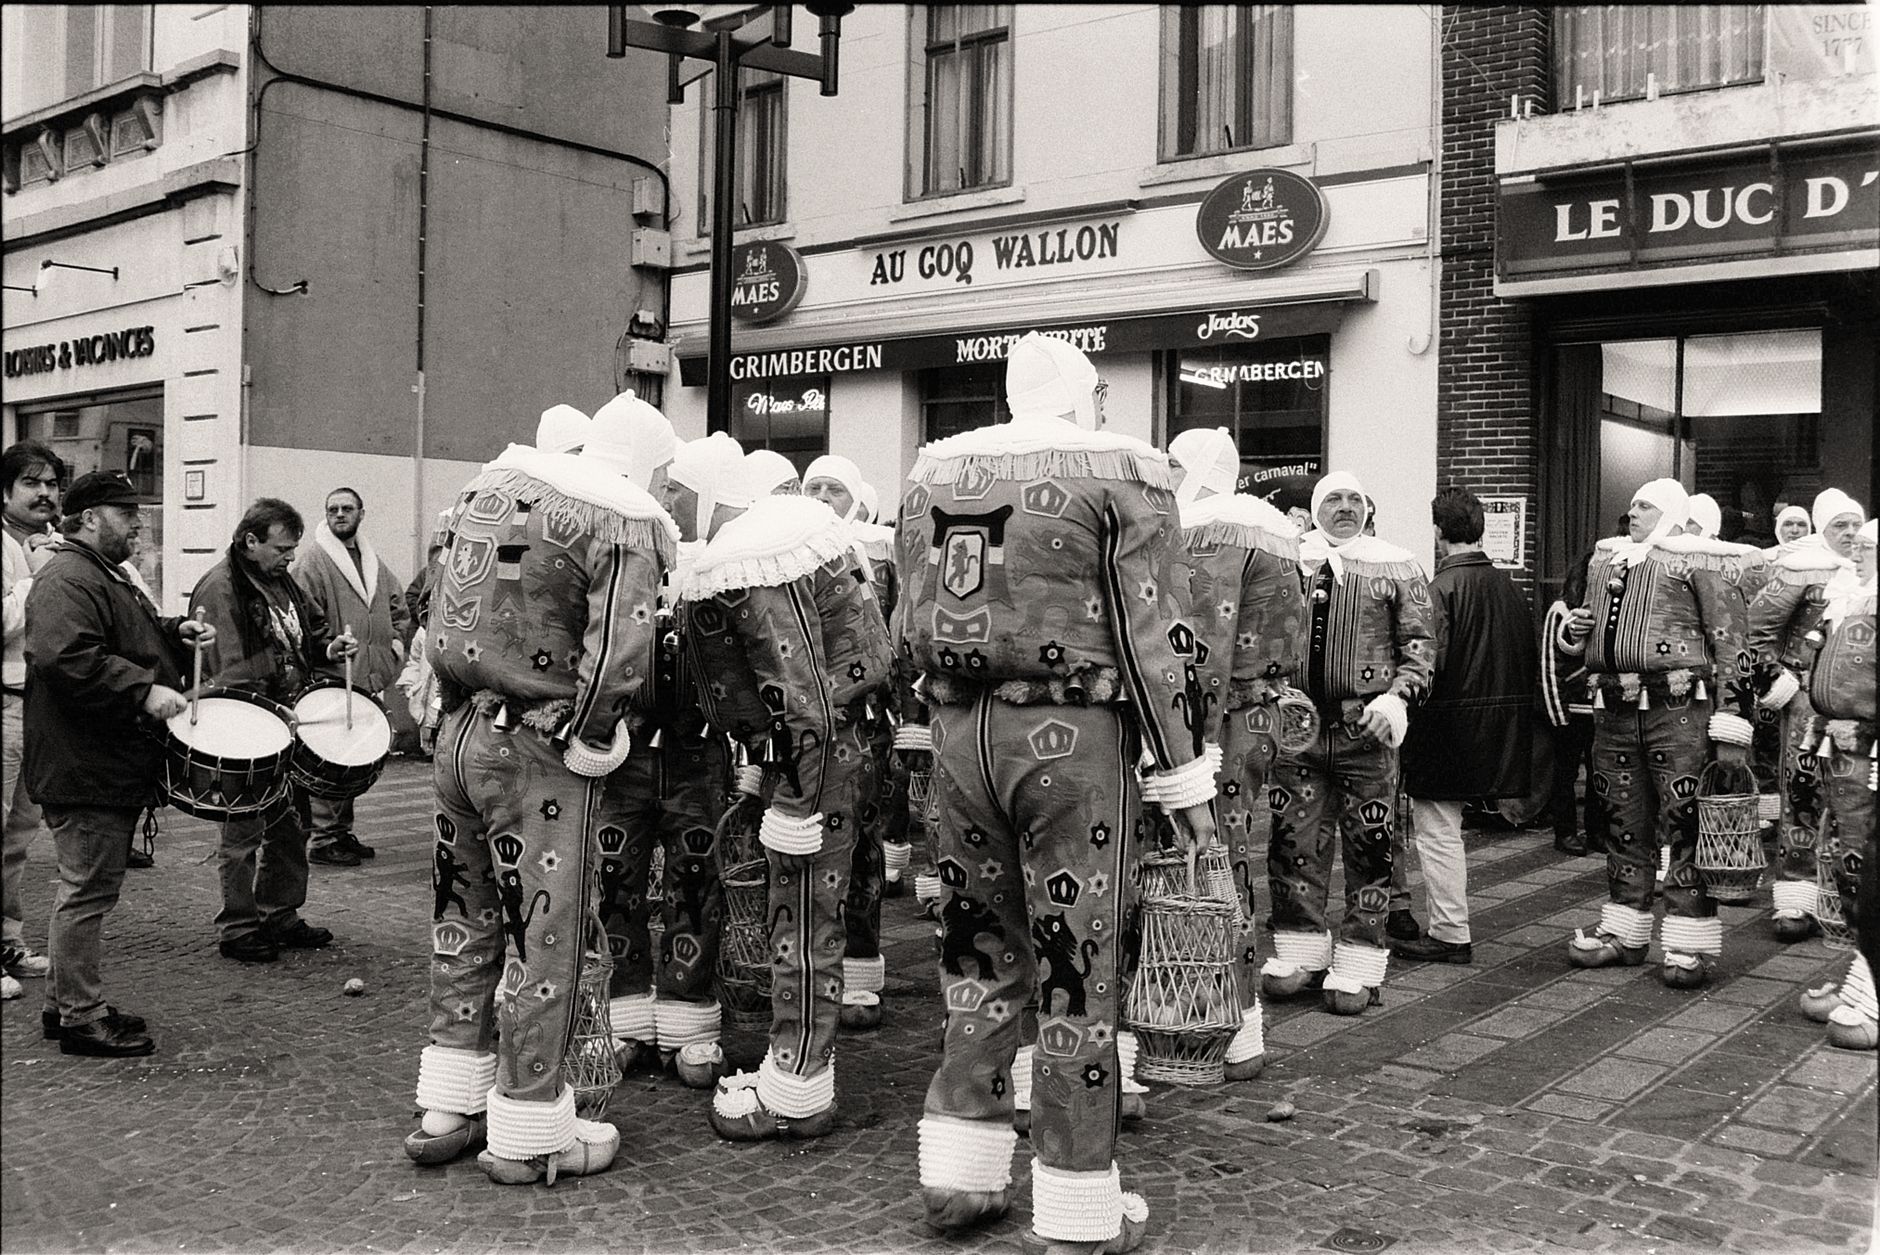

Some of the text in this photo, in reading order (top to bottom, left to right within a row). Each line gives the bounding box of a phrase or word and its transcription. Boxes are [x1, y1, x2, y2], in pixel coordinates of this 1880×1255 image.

[1554, 199, 1621, 242] LE
[1648, 182, 1774, 233] DUC
[870, 250, 906, 285] AU
[992, 222, 1120, 270] WALLON
[1217, 219, 1294, 250] MAES
[731, 281, 780, 306] MAES
[58, 341, 72, 369] &
[72, 325, 155, 366] VACANCES
[729, 344, 882, 380] GRIMBERGEN
